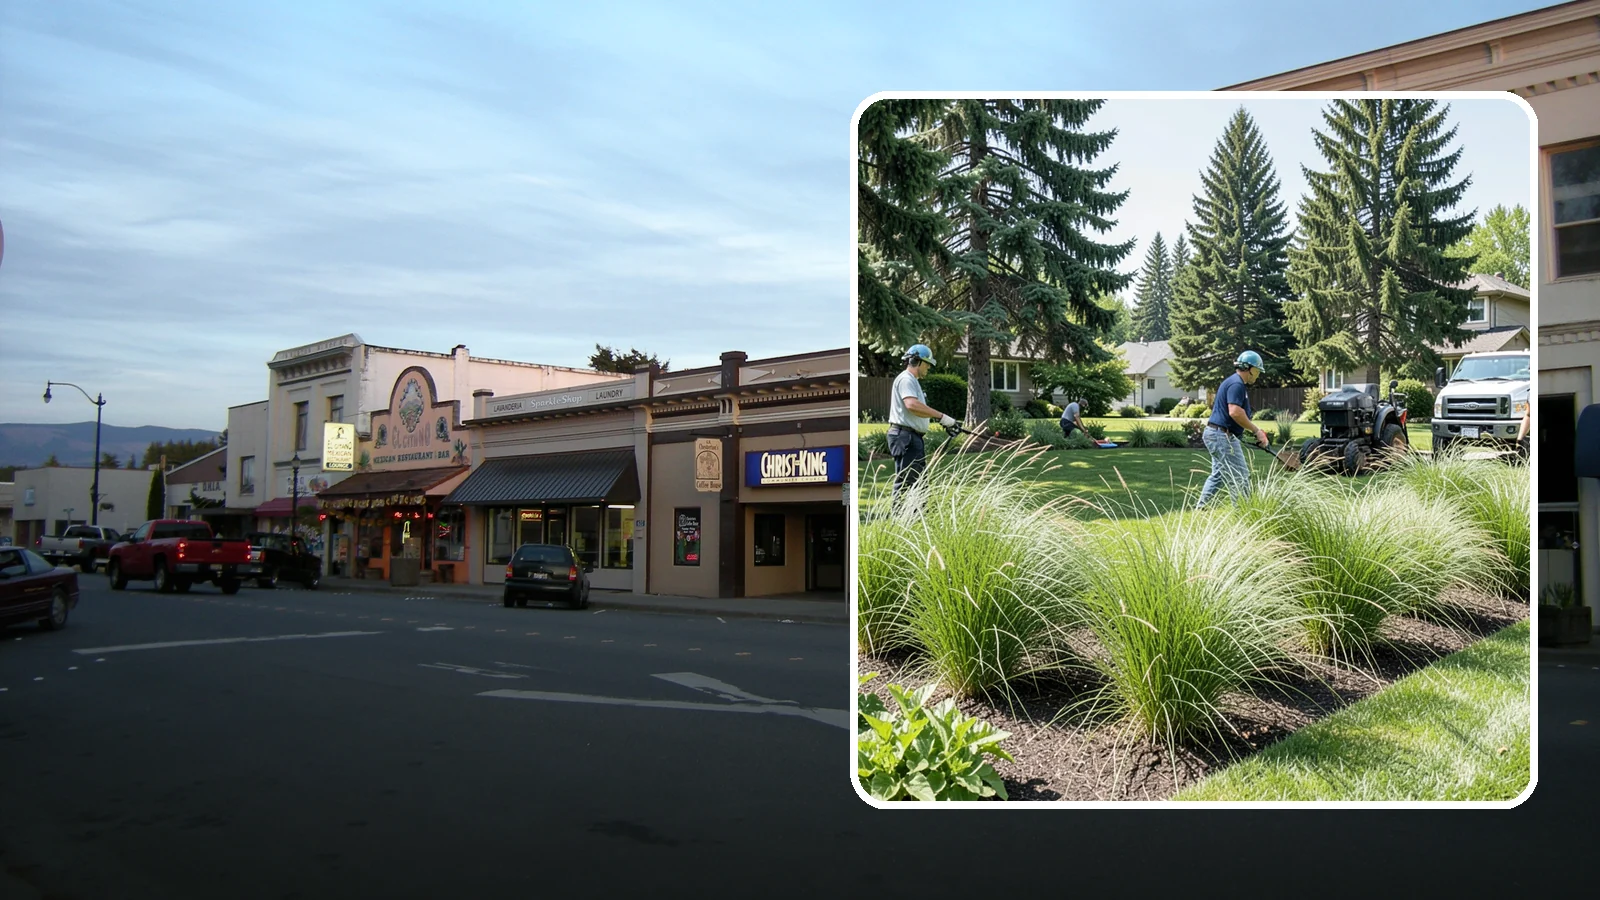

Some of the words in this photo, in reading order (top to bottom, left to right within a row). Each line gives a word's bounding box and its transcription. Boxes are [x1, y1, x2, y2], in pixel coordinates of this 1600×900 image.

[595, 388, 623, 400] LAUNDRY
[493, 402, 523, 412] LAVANDERIA
[530, 397, 561, 409] Sparkle
[561, 394, 582, 405] Shop
[373, 454, 396, 465] MEXICAN
[397, 451, 433, 463] RESTAURANT
[438, 449, 450, 459] BAR
[760, 451, 797, 478] CHRIST
[799, 449, 827, 476] KING
[696, 480, 709, 489] Coffee
[710, 480, 722, 489] House
